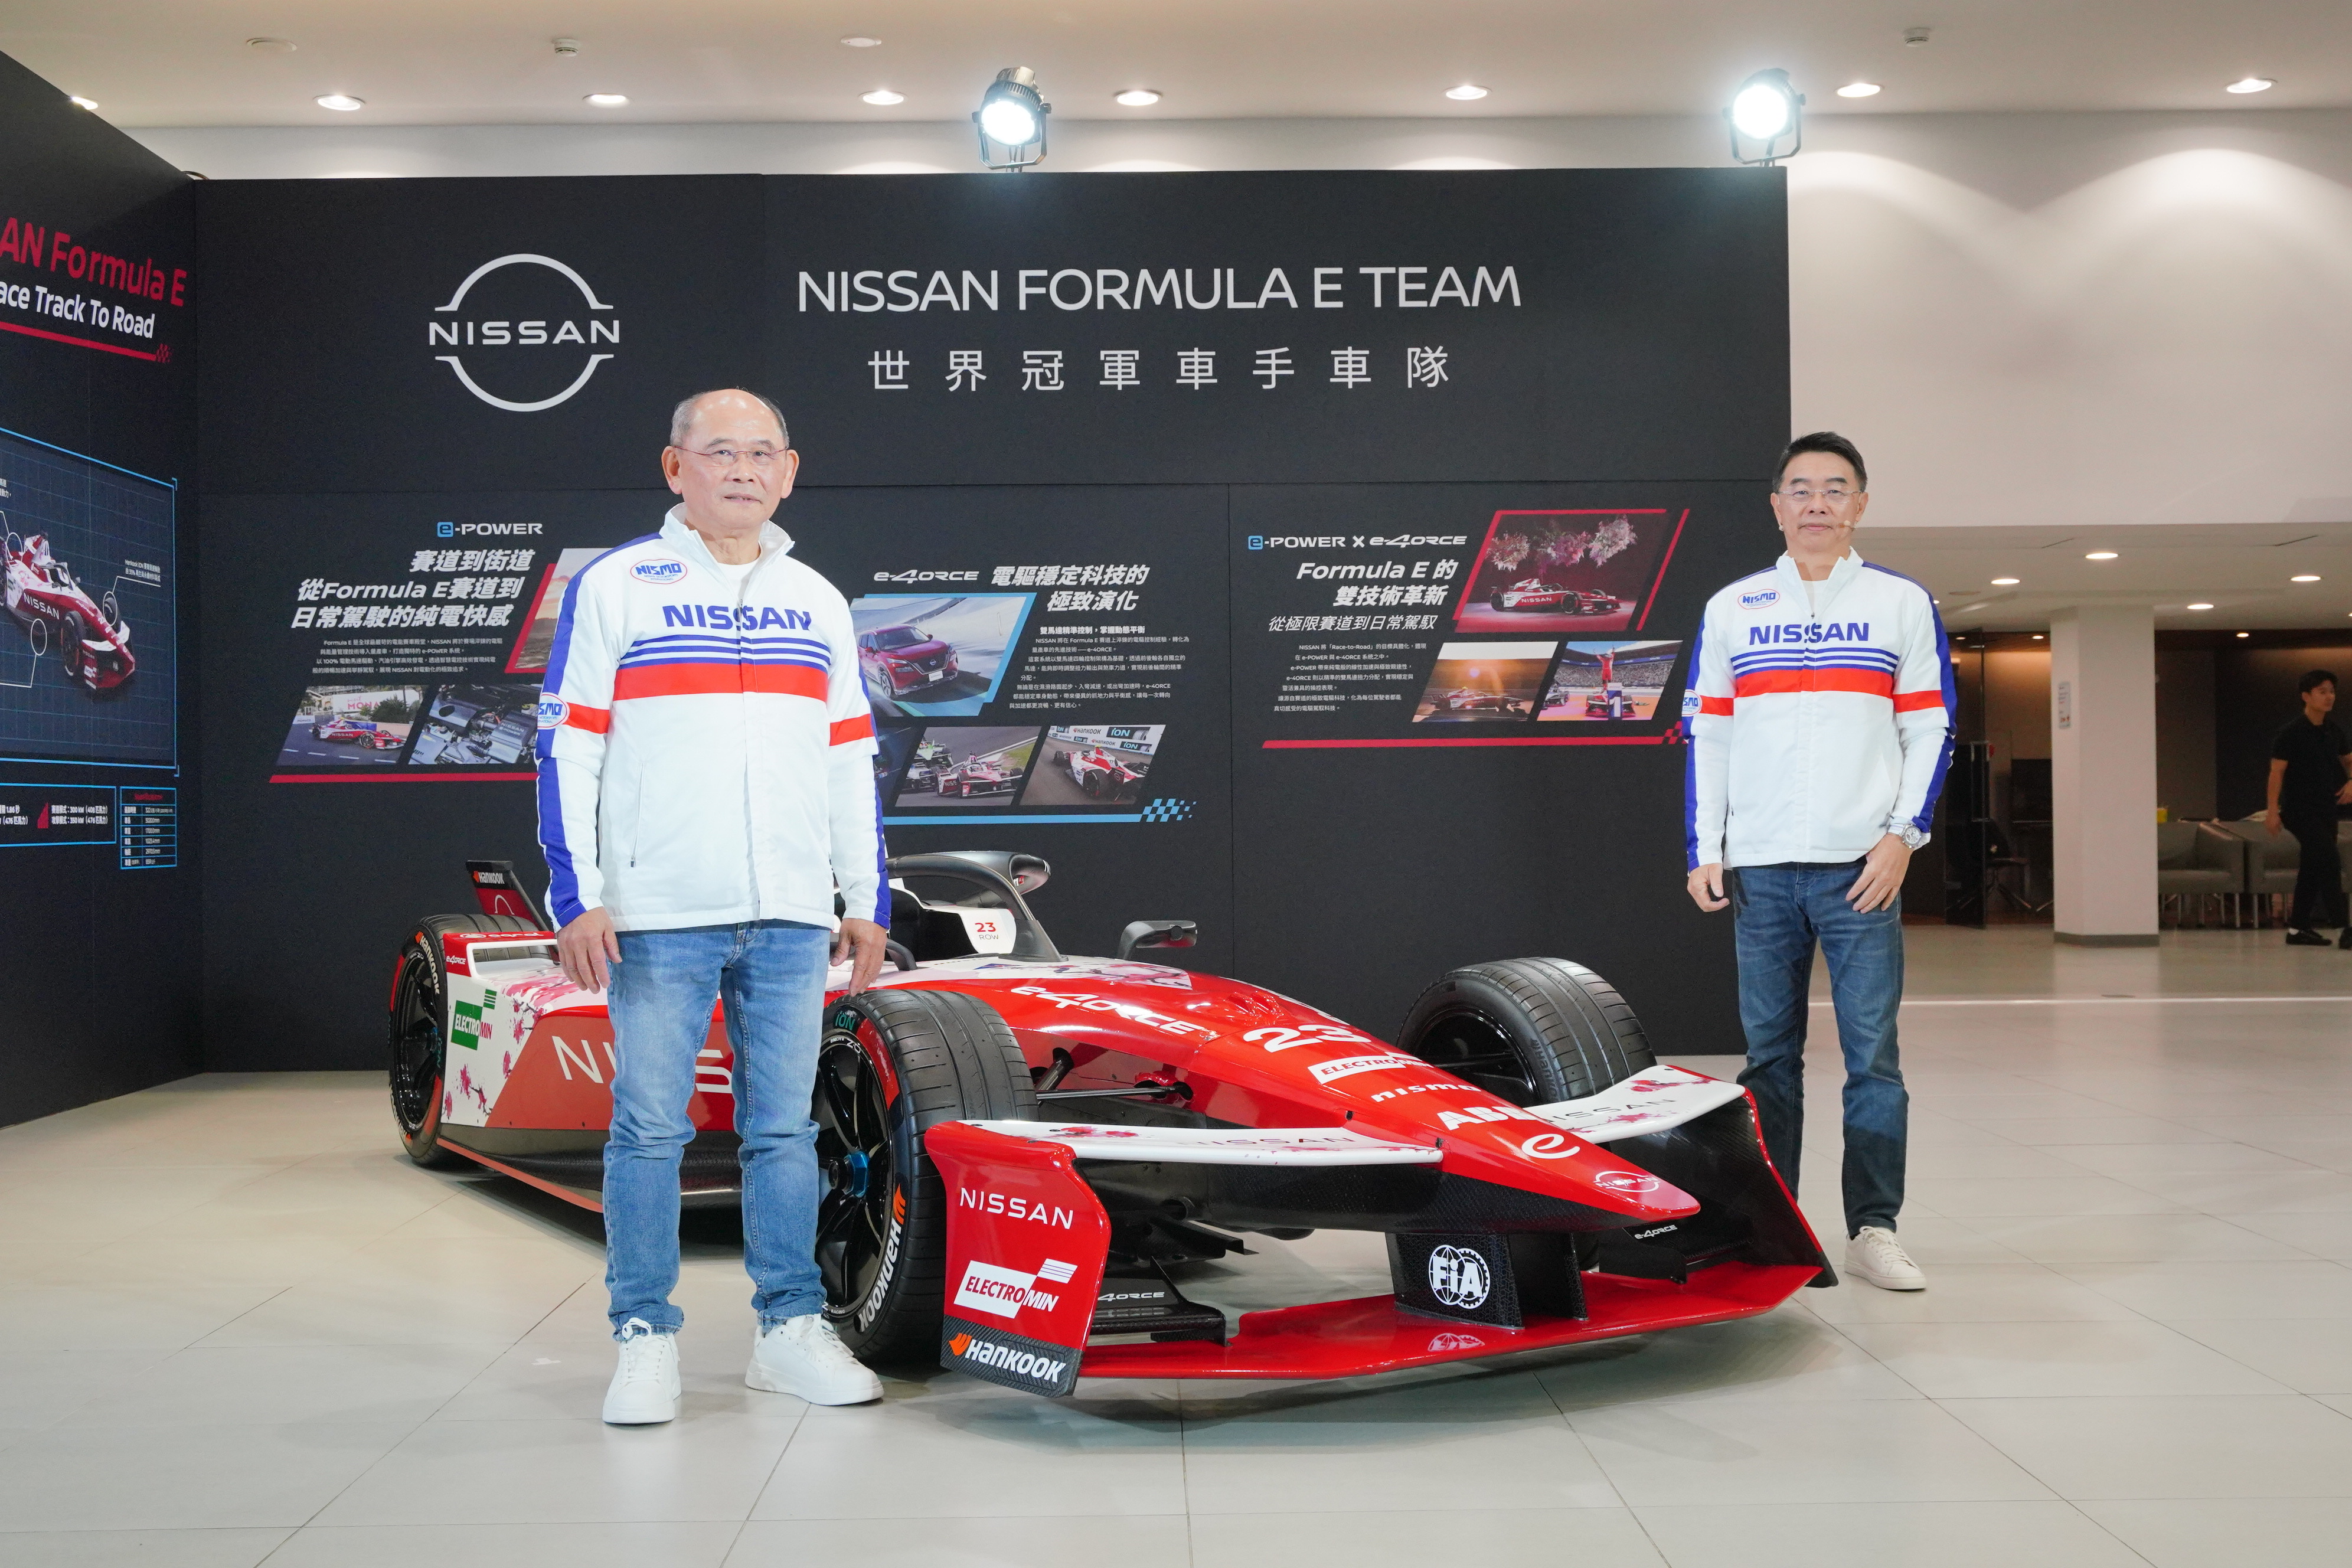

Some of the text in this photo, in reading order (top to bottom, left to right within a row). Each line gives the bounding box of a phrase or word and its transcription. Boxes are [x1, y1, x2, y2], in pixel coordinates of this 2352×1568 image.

[50, 231, 165, 302] Formula
[170, 268, 187, 307] E
[799, 266, 1521, 312] NISSAN FORMULA E TEAM
[35, 286, 84, 323] Track
[90, 299, 109, 328] To
[112, 305, 155, 338] Road
[429, 319, 620, 345] NISSAN
[867, 345, 1449, 391] 世界冠軍車手車隊
[437, 521, 544, 538] e-POWER
[1248, 535, 1346, 550] e-POWER
[409, 549, 536, 573] 賽道到街道
[635, 563, 682, 576] NISMO
[1296, 558, 1459, 580] Formula E 的
[991, 564, 1151, 586] 電驅穩定科技的
[297, 578, 426, 602] 從Formula
[1046, 590, 1139, 612] 極致演化
[1332, 584, 1449, 606] 雙技術革新
[1742, 592, 1776, 604] NISMO
[23, 592, 60, 620] NISSAN
[290, 603, 515, 629] 日常駕駛的純電快感
[662, 604, 812, 631] NISSAN
[1268, 614, 1439, 632] 從極限賽道到日常駕馭
[1749, 622, 1870, 646] NISSAN
[1609, 696, 1621, 717] 1
[975, 922, 996, 932] 23
[454, 1013, 493, 1040] ELECTROMIN
[1243, 1024, 1372, 1053] 23
[1371, 1083, 1481, 1103] nismo
[1595, 1176, 1660, 1188] NISSAN
[959, 1187, 1074, 1230] NISSAN
[965, 1275, 1060, 1313] ELECTROMIN
